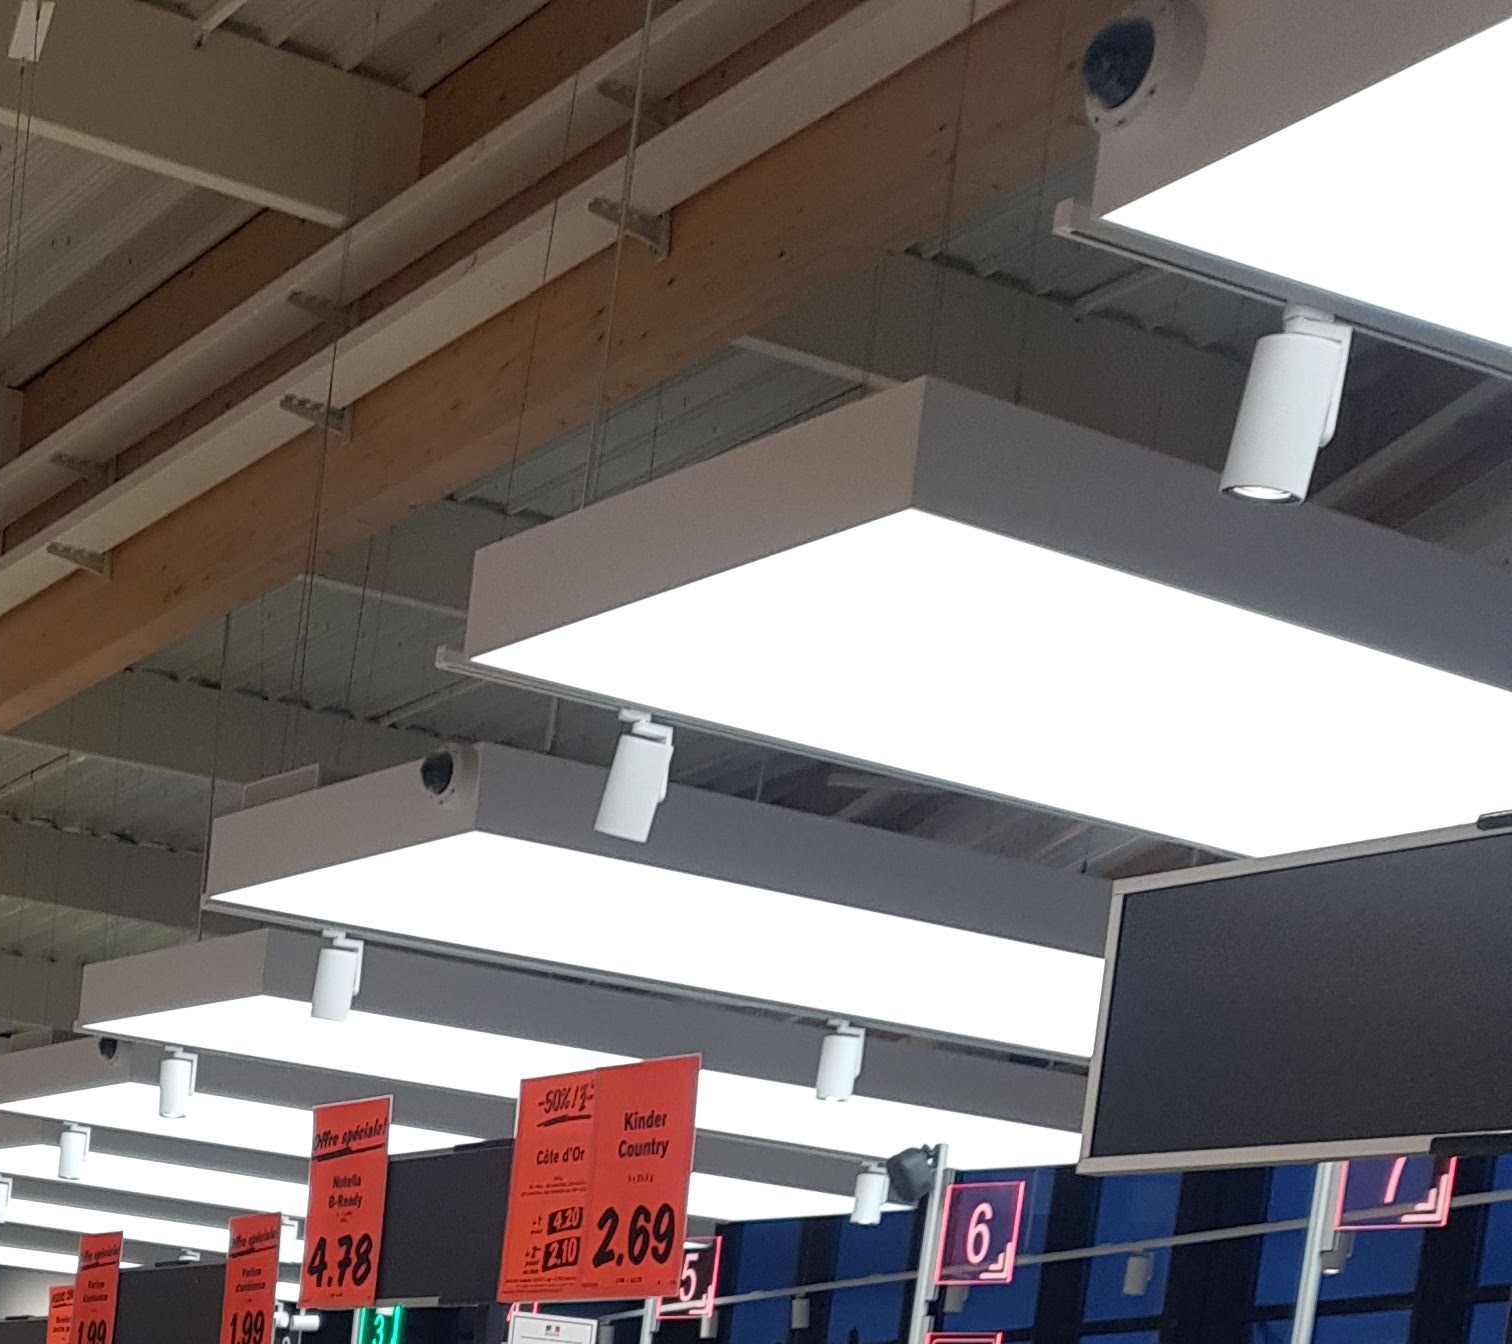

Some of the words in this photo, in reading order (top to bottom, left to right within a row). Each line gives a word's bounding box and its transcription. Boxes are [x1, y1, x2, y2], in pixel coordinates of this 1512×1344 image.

[624, 1112, 668, 1131] Kinder
[536, 1147, 560, 1165] Côte
[562, 1148, 585, 1164] d'Or
[618, 1138, 670, 1160] Country
[332, 1174, 361, 1189] Nutella
[592, 1203, 676, 1269] 2.69
[966, 1202, 992, 1264] 6
[307, 1232, 373, 1288] 4.78
[679, 1252, 700, 1302] 5
